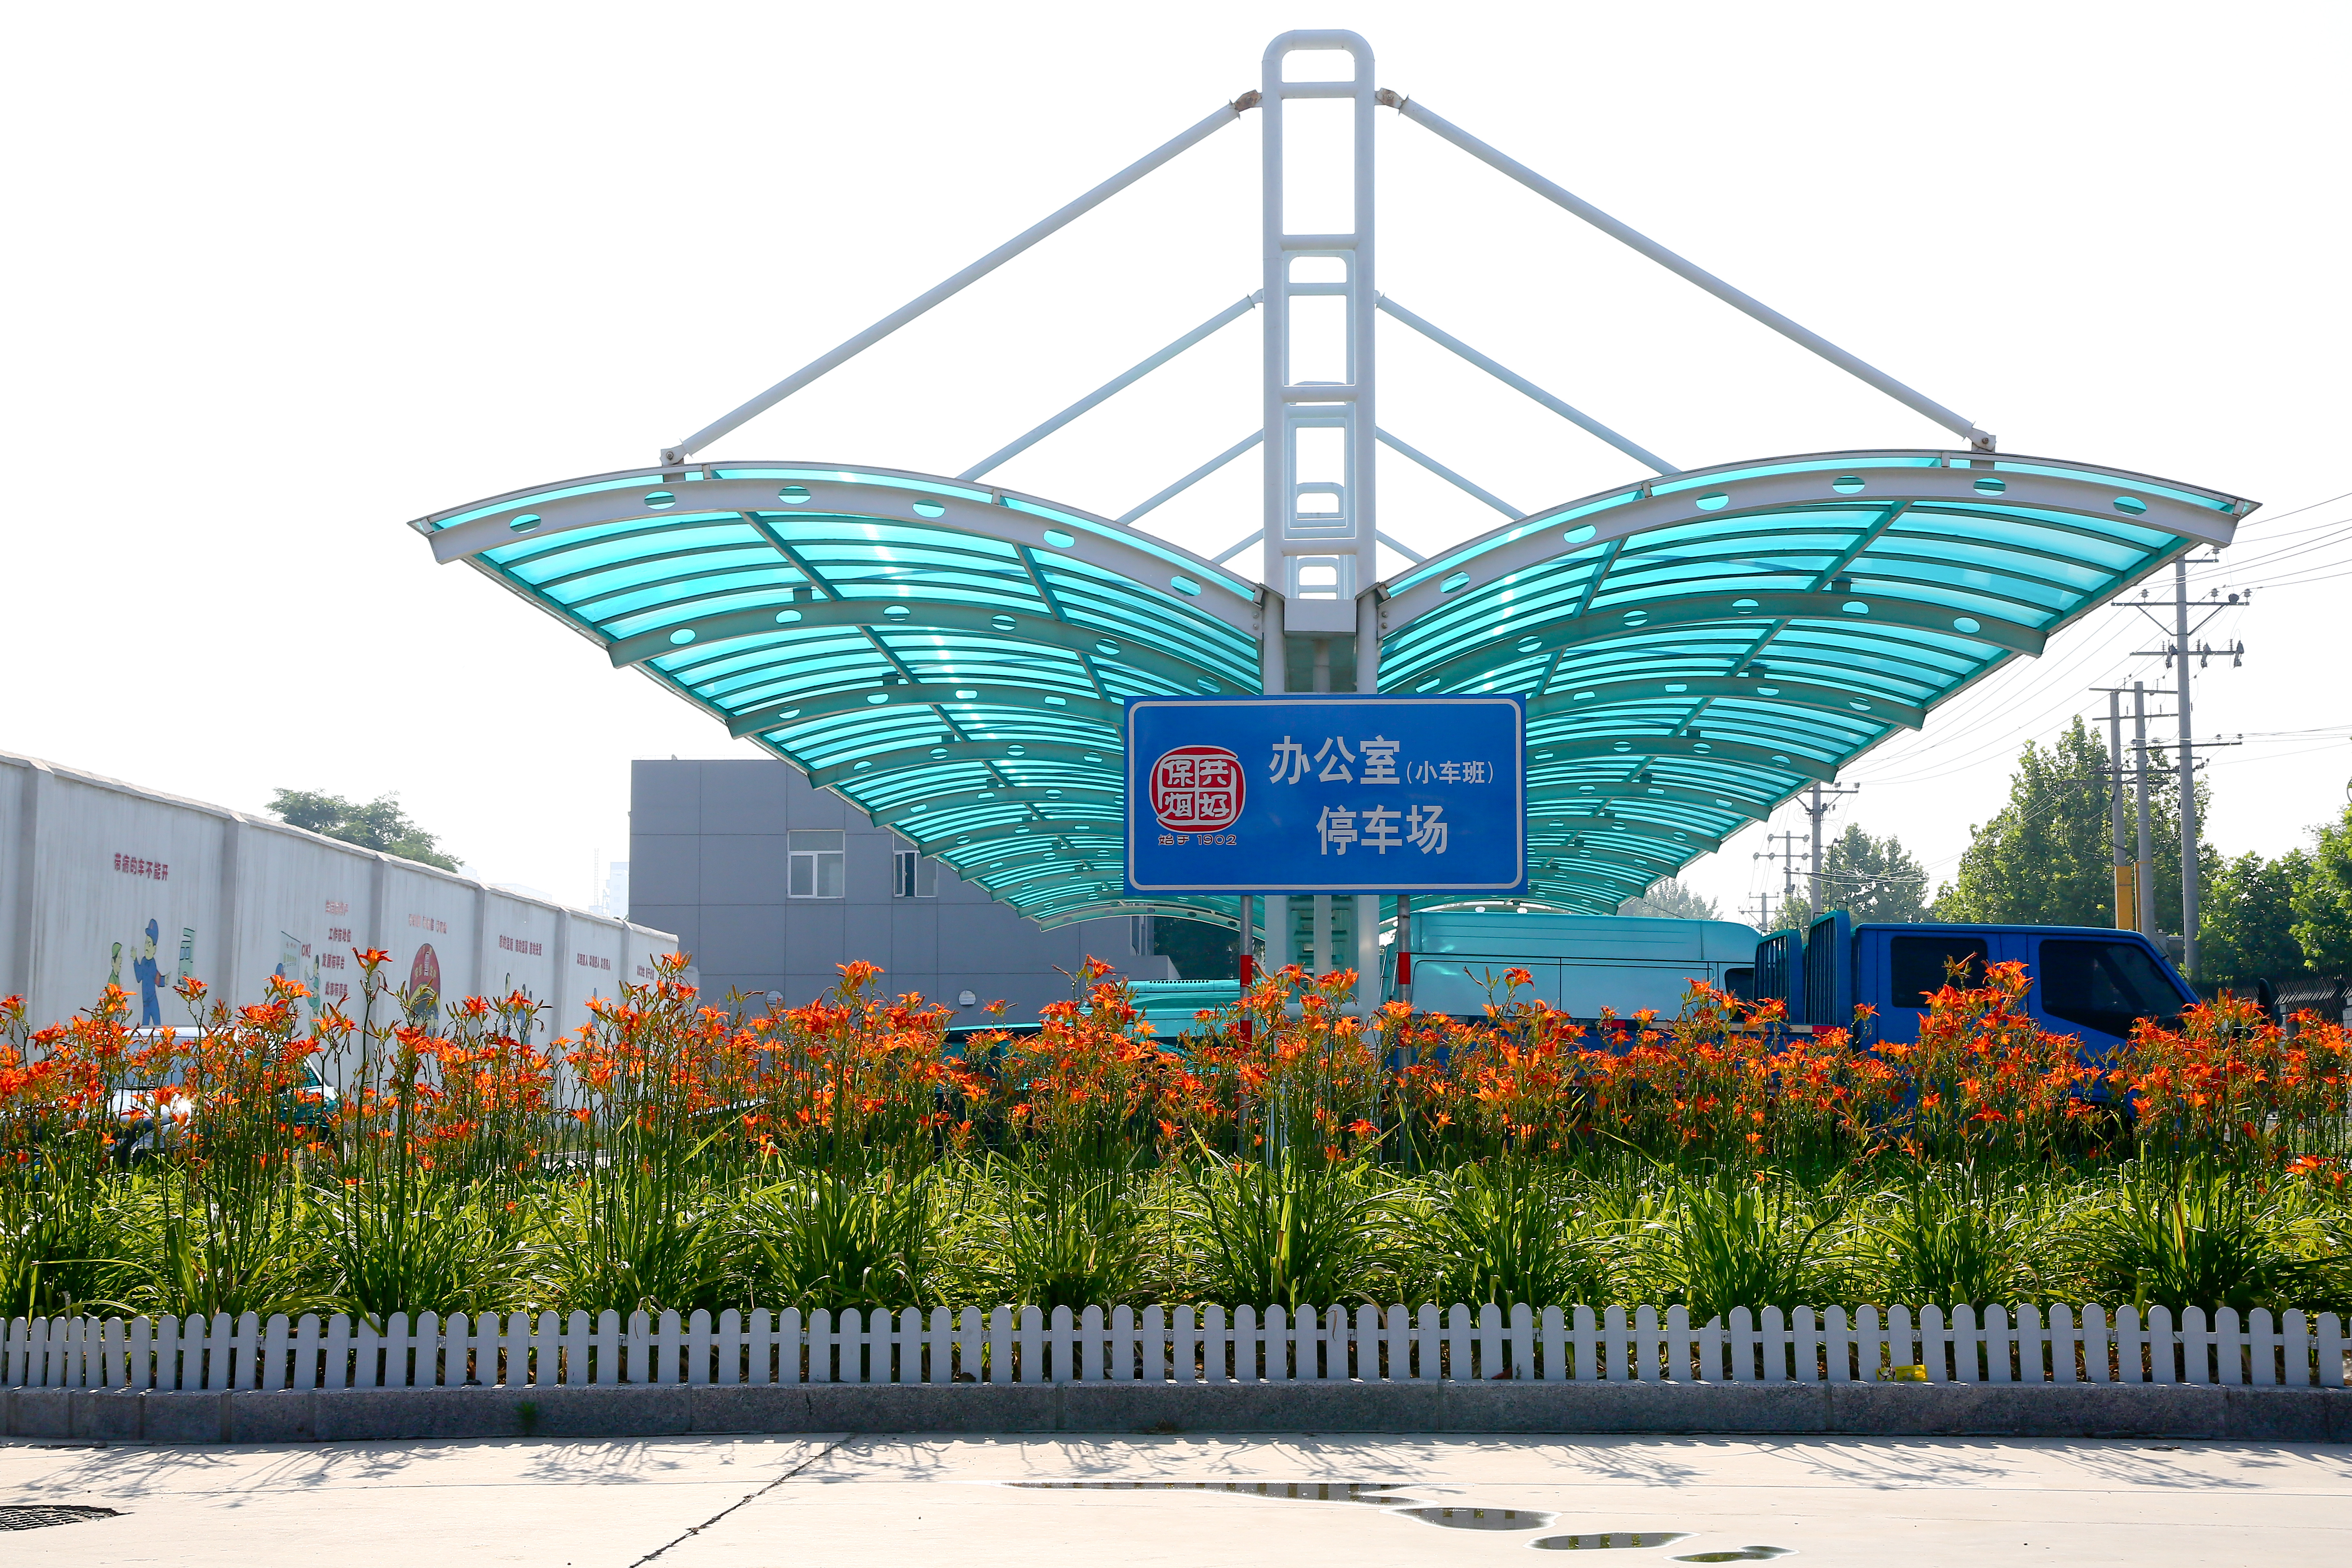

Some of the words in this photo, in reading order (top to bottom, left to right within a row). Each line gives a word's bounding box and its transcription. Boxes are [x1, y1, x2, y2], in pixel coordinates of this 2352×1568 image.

[1269, 735, 1400, 785] 办公室
[1407, 760, 1494, 785] (小车班)
[1316, 804, 1448, 855] 停车场
[1158, 833, 1189, 845] 始于
[1197, 834, 1237, 845] 1902
[115, 852, 168, 881] 带病的车不能开
[328, 927, 351, 942] 工作有地位
[301, 943, 311, 958] OK!
[322, 953, 345, 970] 发展有平台
